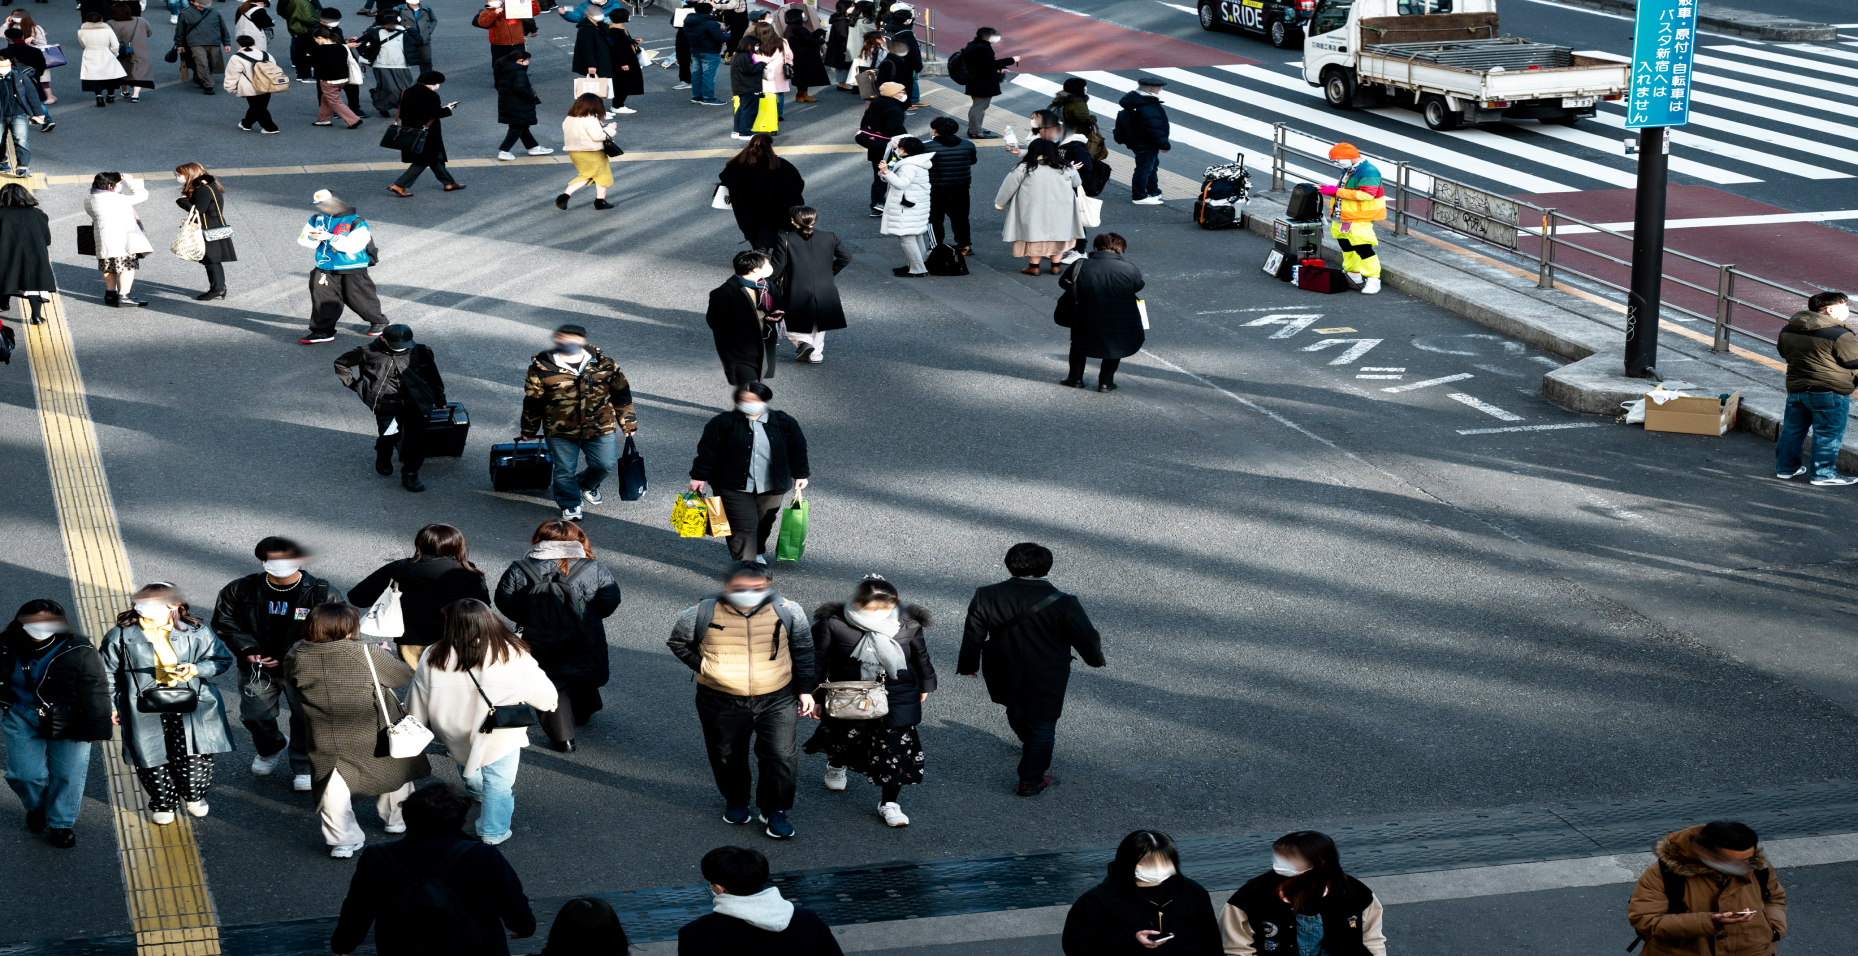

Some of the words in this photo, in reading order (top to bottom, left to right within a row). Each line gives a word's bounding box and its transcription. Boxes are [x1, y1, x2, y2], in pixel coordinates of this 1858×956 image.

[1220, 2, 1264, 29] S.RIDE
[1653, 9, 1675, 97] バスタ新宿へは
[1633, 61, 1652, 123] 入れません
[1239, 314, 1526, 422] タクシー
